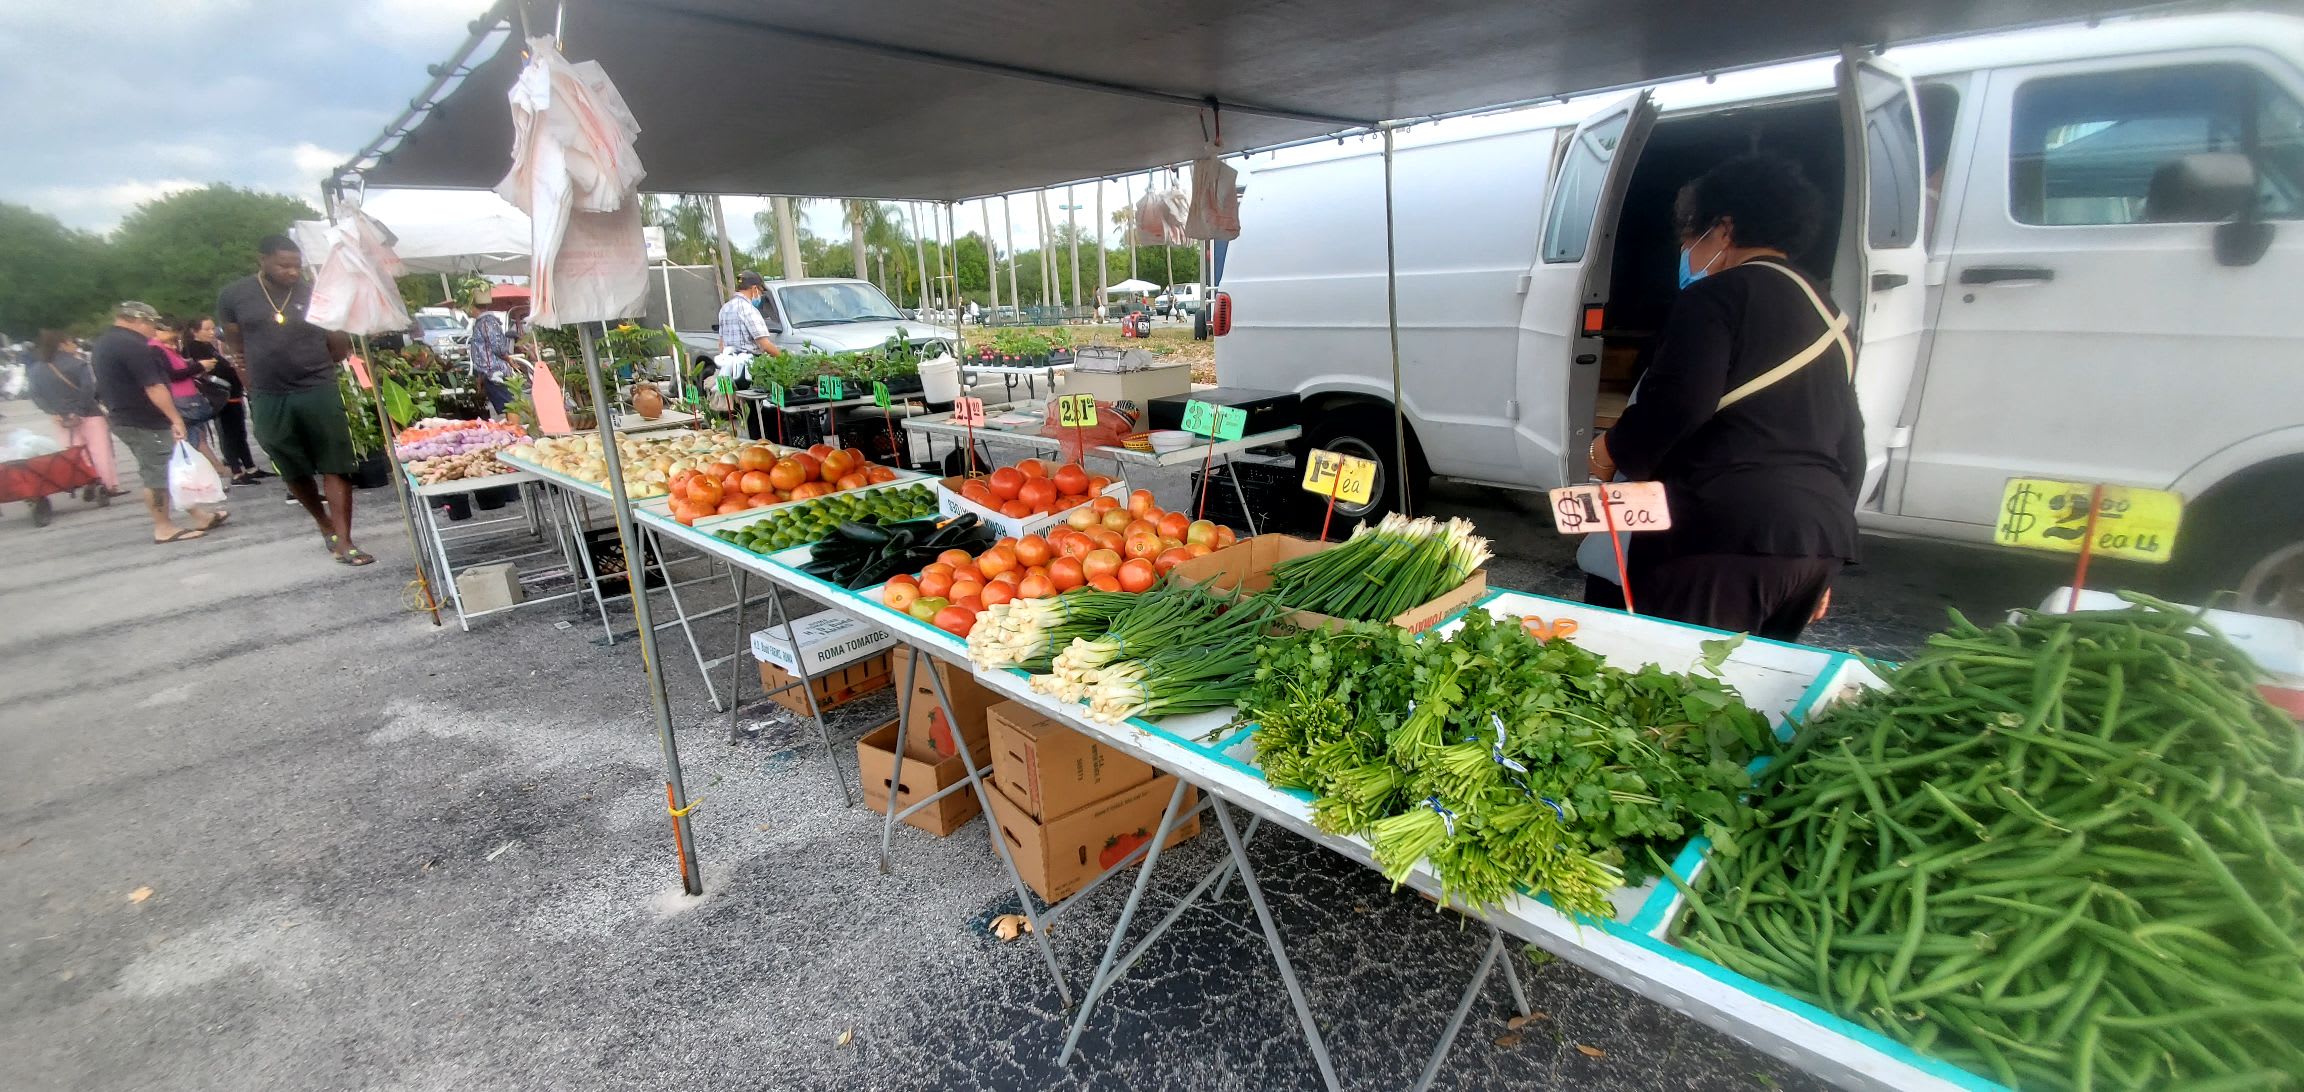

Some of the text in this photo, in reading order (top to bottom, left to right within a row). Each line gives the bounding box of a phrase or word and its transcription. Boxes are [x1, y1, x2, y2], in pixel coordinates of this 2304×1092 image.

[1342, 478, 1360, 493] ea
[1623, 509, 1656, 526] ea
[2100, 533, 2128, 549] ea
[817, 644, 845, 662] ROMA
[845, 629, 889, 652] TOMATOES
